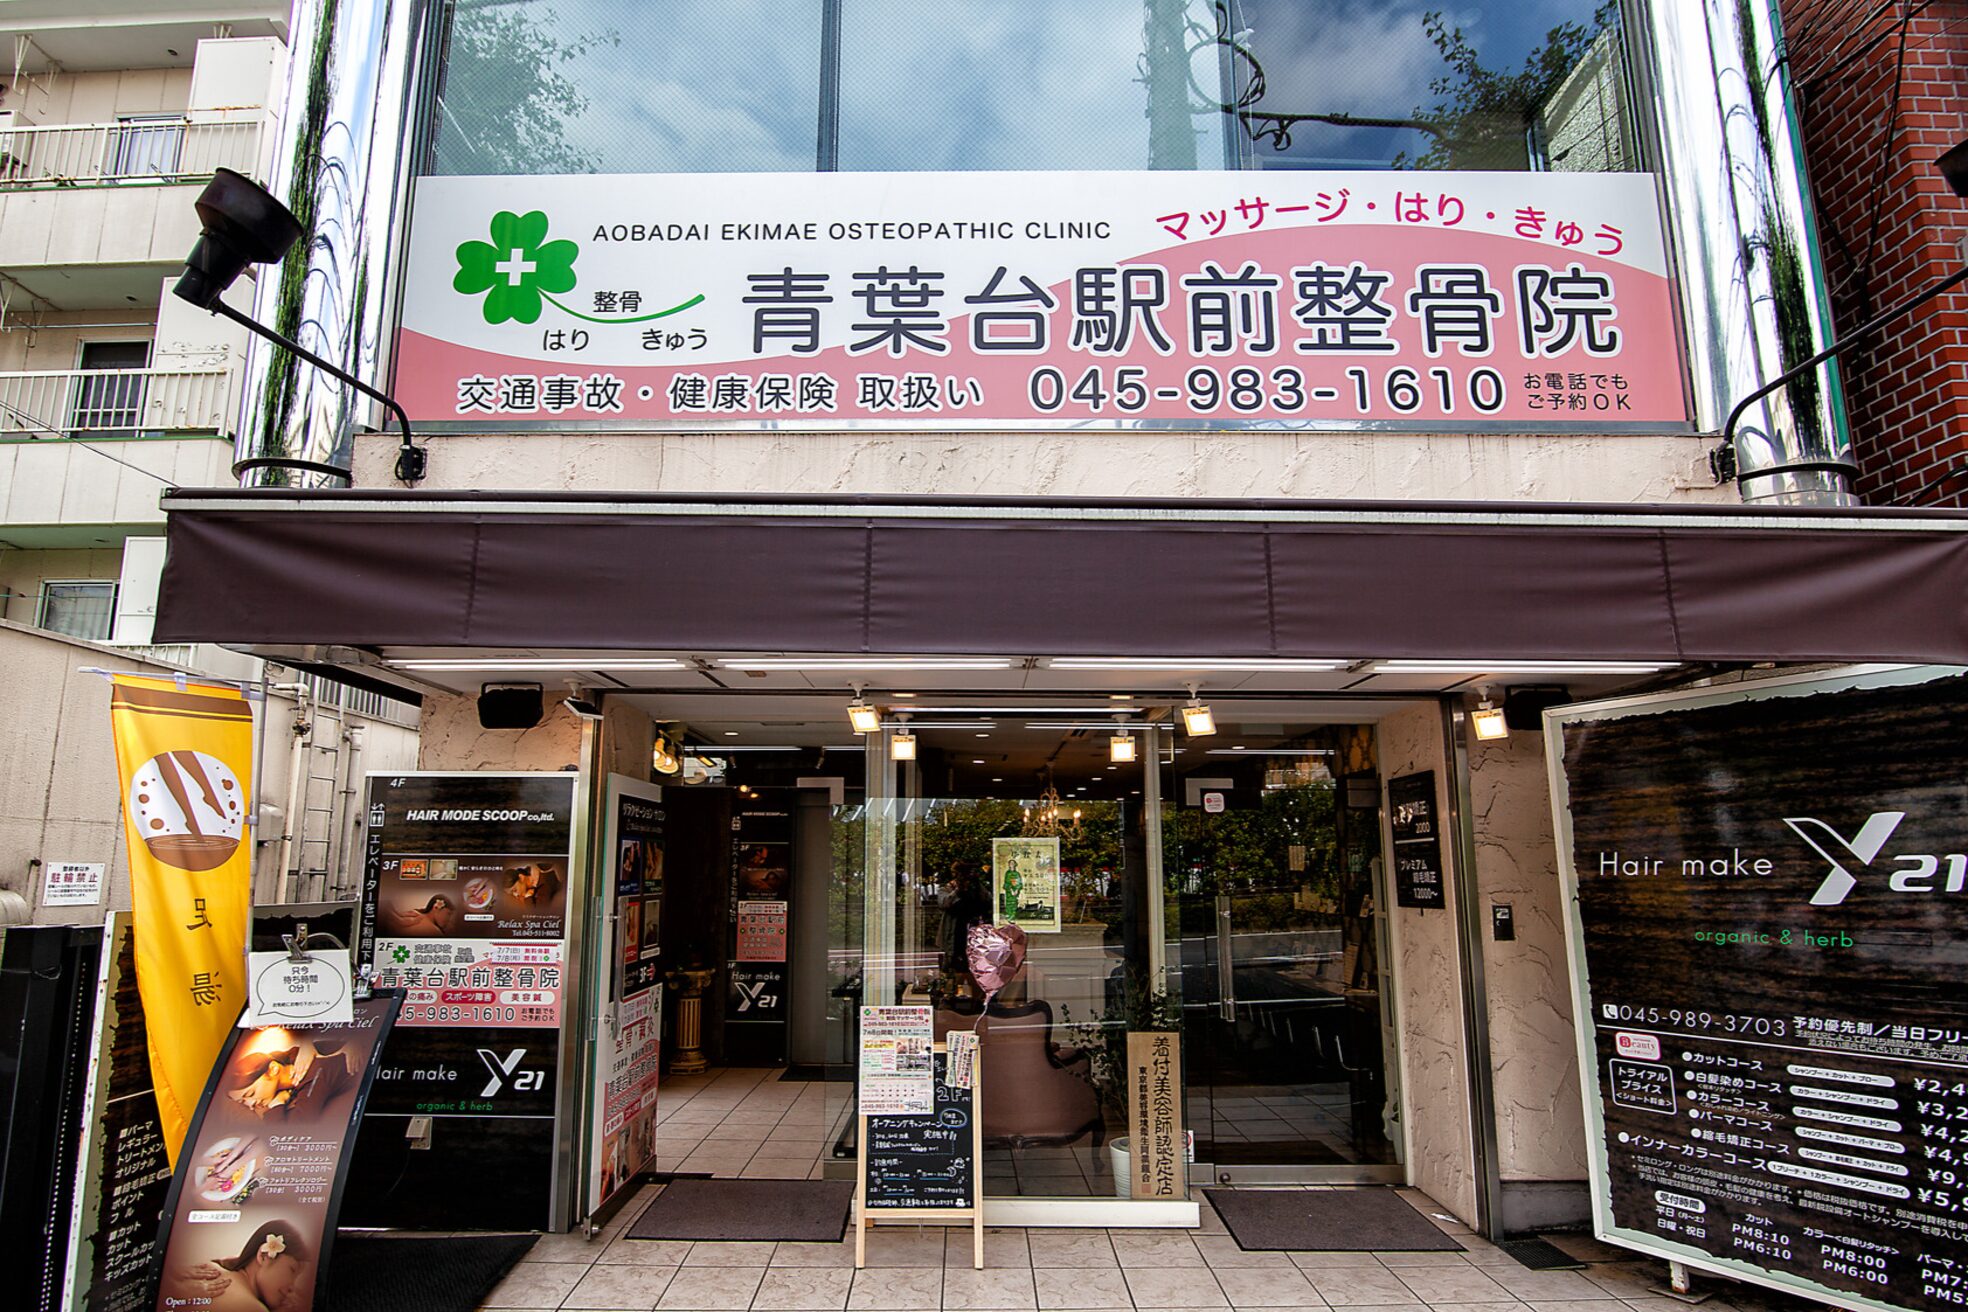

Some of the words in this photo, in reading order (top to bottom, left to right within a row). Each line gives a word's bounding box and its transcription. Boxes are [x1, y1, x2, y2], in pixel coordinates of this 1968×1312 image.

[593, 222, 710, 241] AOBADAI
[722, 222, 818, 241] EKIMAE
[829, 221, 1014, 241] OSTEOPATHIC
[1025, 221, 1111, 240] CLINIC
[1155, 187, 1625, 257] マッサージ・はり・きゅう
[593, 290, 643, 314] 整骨
[741, 263, 1618, 356] 青葉台駅前整骨院
[542, 328, 591, 353] はり
[641, 327, 709, 352] きゅう
[1031, 367, 1504, 412] 045-983-1610
[1523, 372, 1629, 391] お電話でも
[459, 375, 836, 413] 交通事故・健康保険
[859, 376, 983, 410] 取扱い
[1526, 393, 1632, 412] ご予約OK
[390, 777, 406, 788] 4F
[406, 809, 438, 821] HAIR
[441, 809, 480, 821] MODE
[382, 860, 399, 871] 3F
[1400, 859, 1428, 871] プレミアム
[1599, 851, 1664, 876] Hair
[1682, 847, 1774, 876] make
[50, 872, 98, 883] 駐輪禁止
[497, 919, 523, 929] Relax
[524, 919, 541, 931] Spa
[542, 918, 562, 929] Ciel
[378, 942, 394, 951] 2F
[1694, 929, 1770, 946] organic
[1779, 929, 1794, 946] &
[1804, 929, 1854, 948] herb
[283, 974, 319, 984] 待ち時間
[291, 965, 309, 975] 只今
[382, 967, 560, 989] 青葉台駅前整骨院
[731, 971, 751, 981] Hair
[755, 971, 780, 981] make
[403, 992, 435, 1002] の痛み
[348, 1015, 376, 1029] Ciel
[398, 1006, 516, 1022] 5-983-1610
[1619, 1004, 1786, 1037] 045-989-3703
[1693, 1052, 1763, 1071] カットコース
[412, 1063, 458, 1081] make
[1618, 1066, 1668, 1082] トライアル
[1832, 1071, 1849, 1080] カット
[1859, 1074, 1878, 1083] ブロー
[1621, 1079, 1663, 1095] プライス
[1695, 1071, 1783, 1094] 白髪染めコース
[1914, 1077, 1968, 1097] ¥2,4
[416, 1101, 455, 1112] organic
[458, 1101, 466, 1111] &
[469, 1100, 494, 1112] herb
[1698, 1090, 1771, 1112] カラーコース
[1151, 1035, 1175, 1197] 着付美容師認定店
[1699, 1110, 1774, 1132] パーマコース
[117, 1133, 159, 1154] レギュラー
[1630, 1133, 1768, 1171] インナーカラーコース
[1702, 1129, 1791, 1155] 縮毛矯正コース
[116, 1142, 167, 1167] トリートメン
[114, 1157, 157, 1180] オリジナル
[1927, 1167, 1968, 1189] ¥9,
[111, 1190, 145, 1211] ポイント
[1659, 1191, 1701, 1210] 受付時間
[1657, 1217, 1706, 1239] 日曜・祝日
[1745, 1212, 1774, 1227] カット
[116, 1221, 142, 1240] カット
[1732, 1223, 1790, 1246] PM8:10
[106, 1236, 132, 1256] カット
[1733, 1236, 1792, 1261] PM6:10
[1820, 1244, 1887, 1269] PM8:00
[104, 1252, 153, 1283] キッズカット
[1822, 1259, 1889, 1285] PM6:00
[165, 1297, 187, 1307] Open
